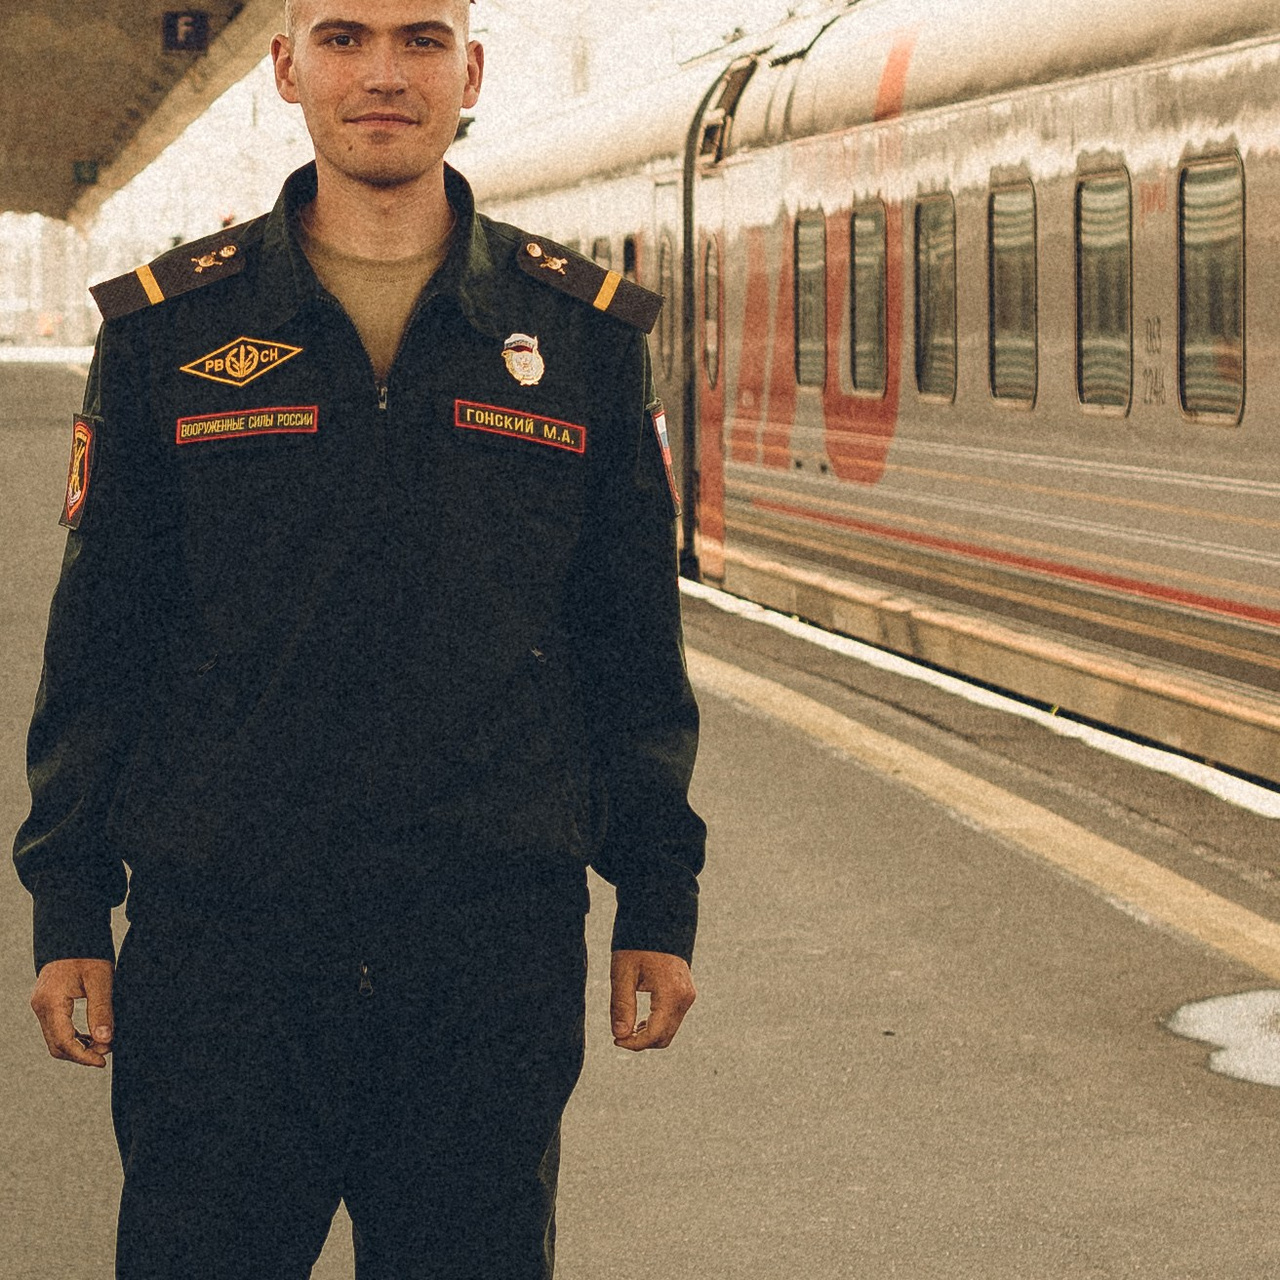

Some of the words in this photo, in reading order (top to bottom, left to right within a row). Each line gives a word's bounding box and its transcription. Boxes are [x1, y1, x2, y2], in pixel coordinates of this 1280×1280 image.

[177, 16, 194, 41] F
[181, 417, 245, 438] ВООРУЖЕННЫЕ
[248, 414, 274, 429] СИЛЫ
[277, 413, 313, 426] РОССИИ
[466, 408, 534, 434] ГОНСКИЙ
[543, 424, 575, 445] М.А.
